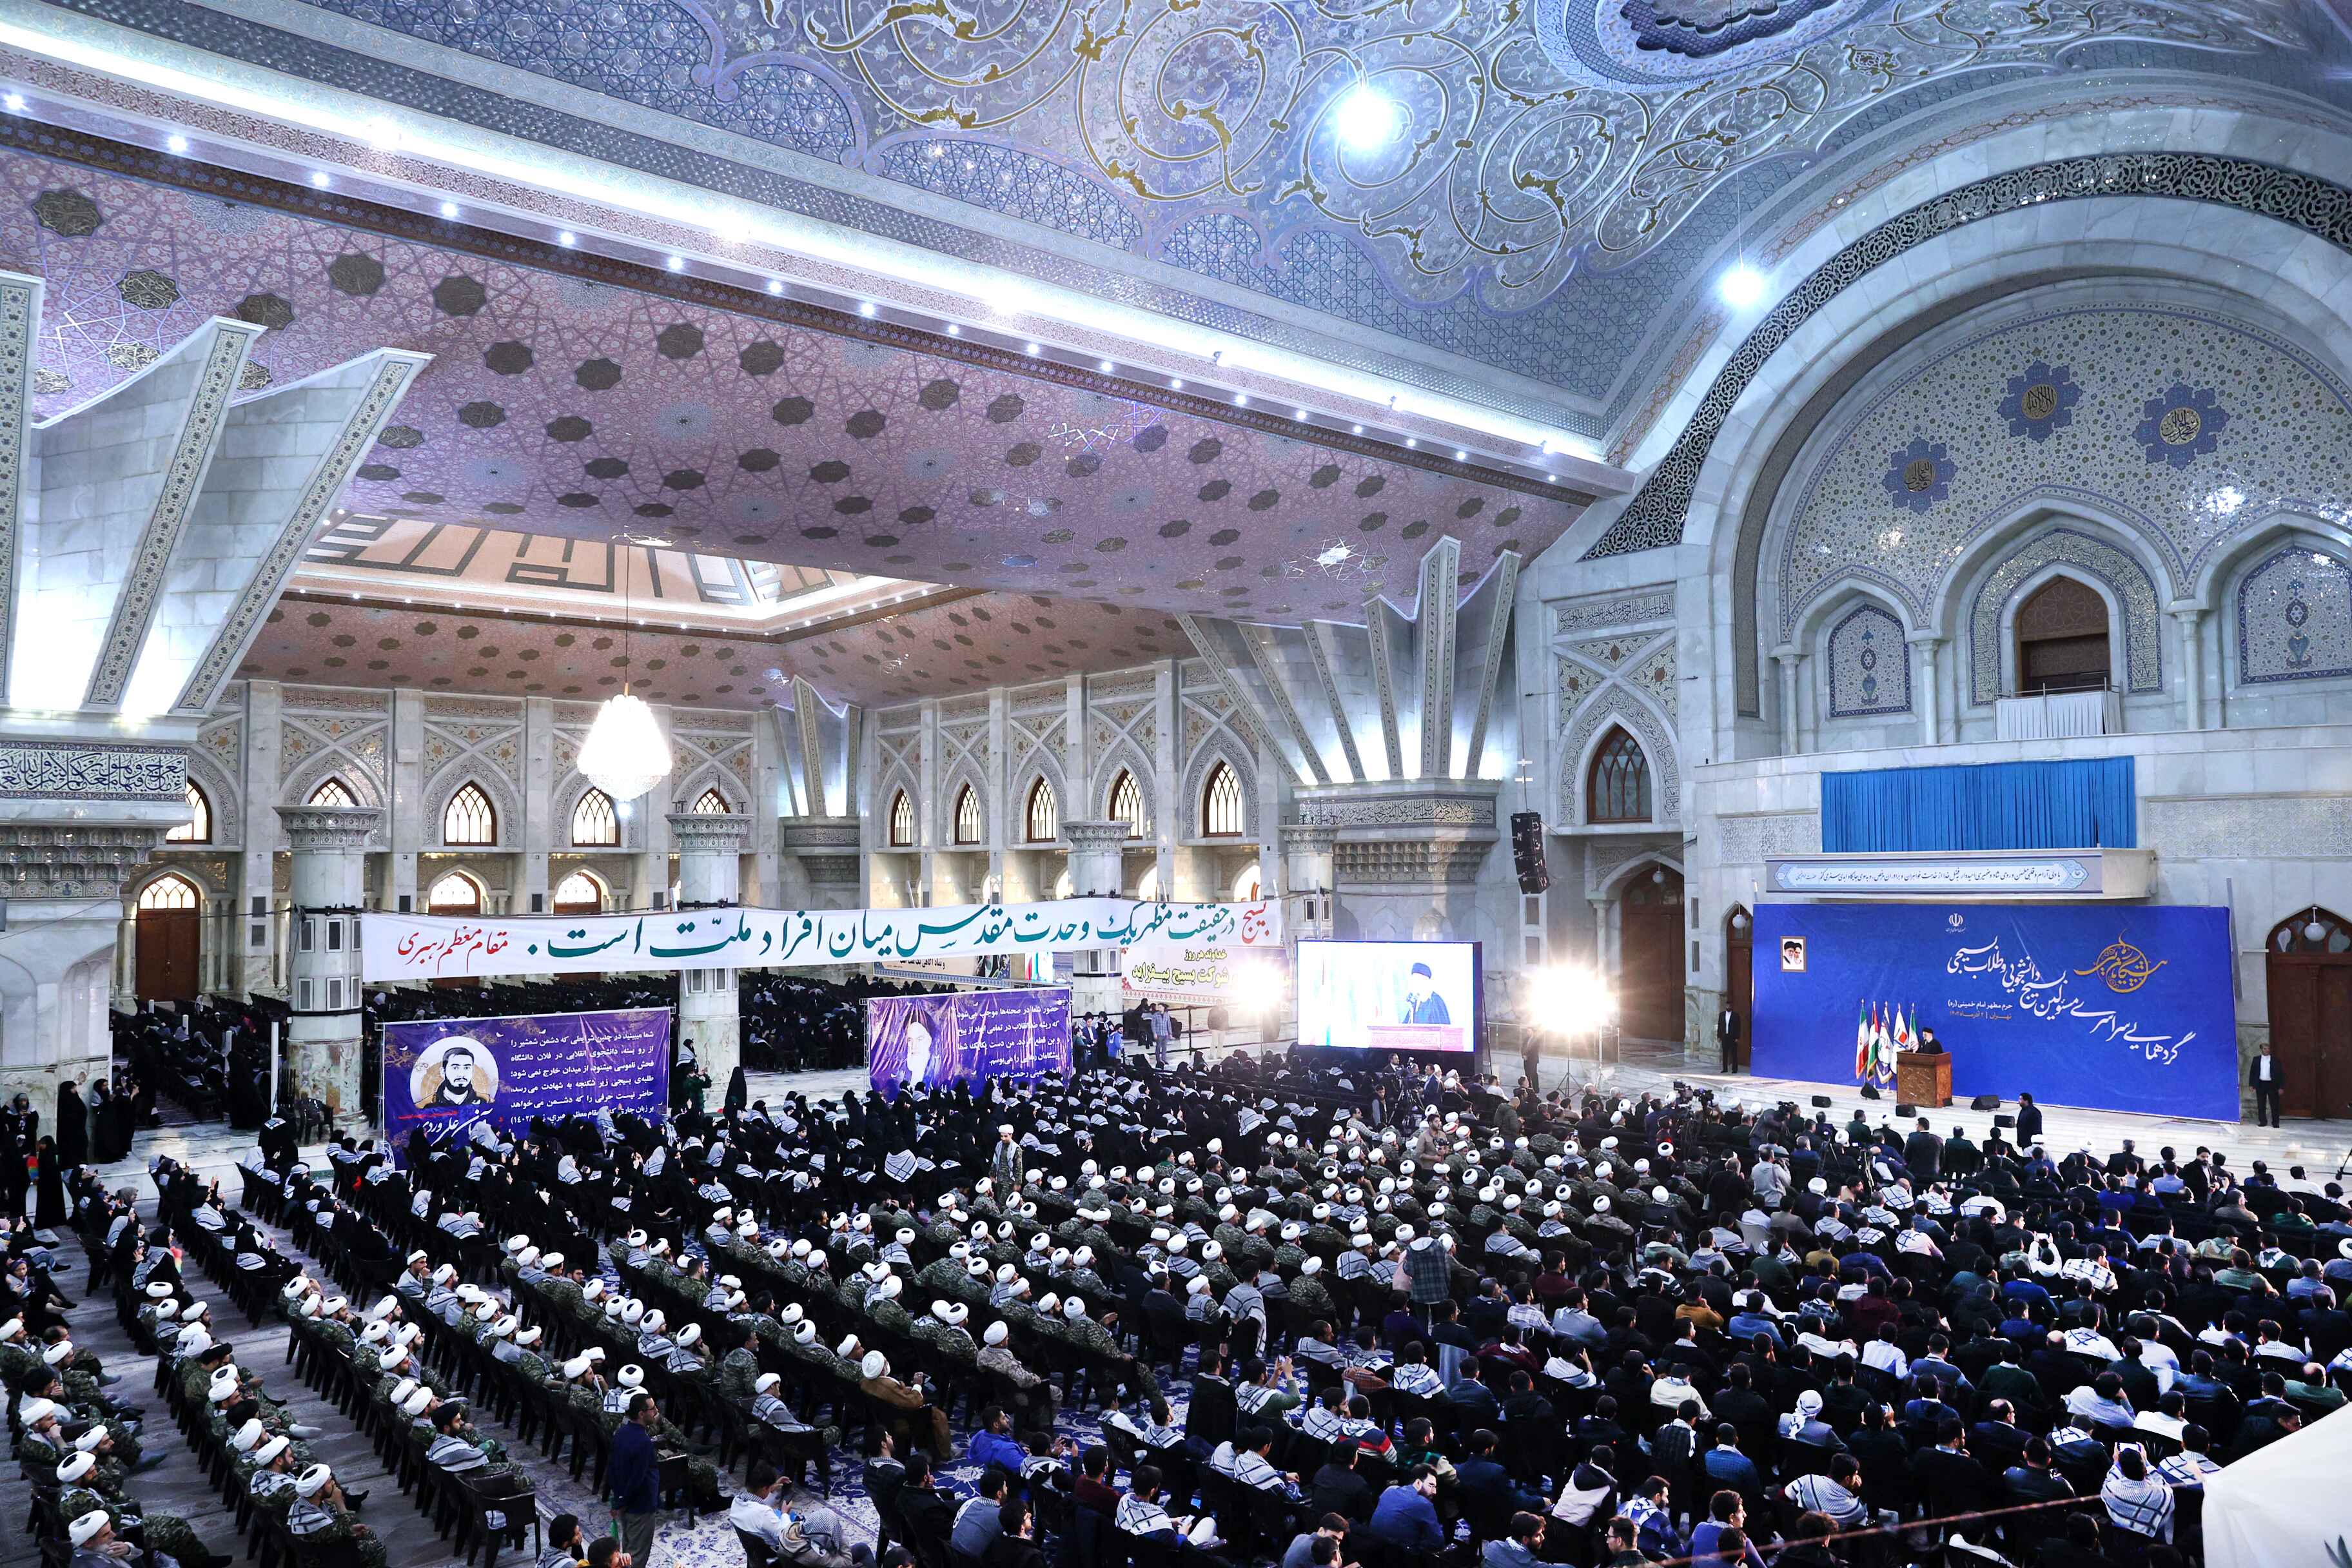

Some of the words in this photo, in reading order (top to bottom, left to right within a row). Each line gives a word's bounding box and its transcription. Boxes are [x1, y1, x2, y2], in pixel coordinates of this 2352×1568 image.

[1014, 912, 1090, 943] وحدت
[1096, 901, 1146, 945] یک
[1133, 903, 1173, 943] مظهر
[1168, 903, 1230, 943] حقیقت
[1221, 917, 1235, 935] در
[1242, 900, 1269, 944] بسیج
[760, 908, 824, 961] افراد
[828, 908, 892, 958] میان
[398, 926, 445, 965] رهبری
[437, 925, 482, 975] معظم
[466, 928, 509, 974] مقام
[1184, 948, 1195, 961] روز
[1196, 950, 1205, 962] هر
[1204, 948, 1227, 963] خداوند
[1946, 935, 1999, 974] بسیجی
[1964, 950, 2004, 979] طلاب
[1132, 962, 1170, 985] بیفزاید
[1171, 966, 1196, 985] بسیج
[1197, 966, 1230, 988] شوکت
[2001, 956, 2041, 993] دانشجویی
[2019, 969, 2068, 1009] بسیج
[1976, 1001, 1986, 1010] امام
[2034, 984, 2079, 1020] مسئولین
[979, 1010, 999, 1019] موجب
[1043, 1005, 1059, 1015] حضور
[1990, 1012, 2012, 1020] تهران
[2070, 1001, 2131, 1042] سراسری
[968, 1026, 974, 1035] از
[986, 1024, 1003, 1035] تمامی
[1039, 1021, 1052, 1030] ریشه
[959, 1027, 967, 1037] بیخ
[511, 1039, 517, 1048] را
[518, 1037, 538, 1048] شمشیر
[539, 1037, 560, 1046] دشمن
[596, 1035, 612, 1043] چنین
[2122, 1021, 2197, 1065] گردهمایی
[589, 1048, 618, 1058] دانشجوی
[648, 1045, 654, 1054] از
[511, 1054, 534, 1062] دانشگاه
[536, 1052, 552, 1061] فلان
[554, 1052, 563, 1061] در
[566, 1050, 587, 1061] انقلابی
[582, 1064, 589, 1073] از
[614, 1061, 636, 1072] ناموسی
[637, 1059, 654, 1070] فحش
[542, 1067, 561, 1077] خارج
[562, 1066, 582, 1075] میدان
[1030, 1068, 1047, 1079] خمینی
[541, 1081, 564, 1091] شهادت
[575, 1079, 596, 1089] شکنجه
[598, 1078, 609, 1088] زیر
[611, 1078, 632, 1087] بسیجی
[586, 1095, 593, 1103] را
[594, 1093, 614, 1103] حرفی
[616, 1091, 636, 1100] نیست
[637, 1090, 654, 1100] حاضر
[546, 1096, 573, 1108] دشمن
[635, 1105, 648, 1113] زبان
